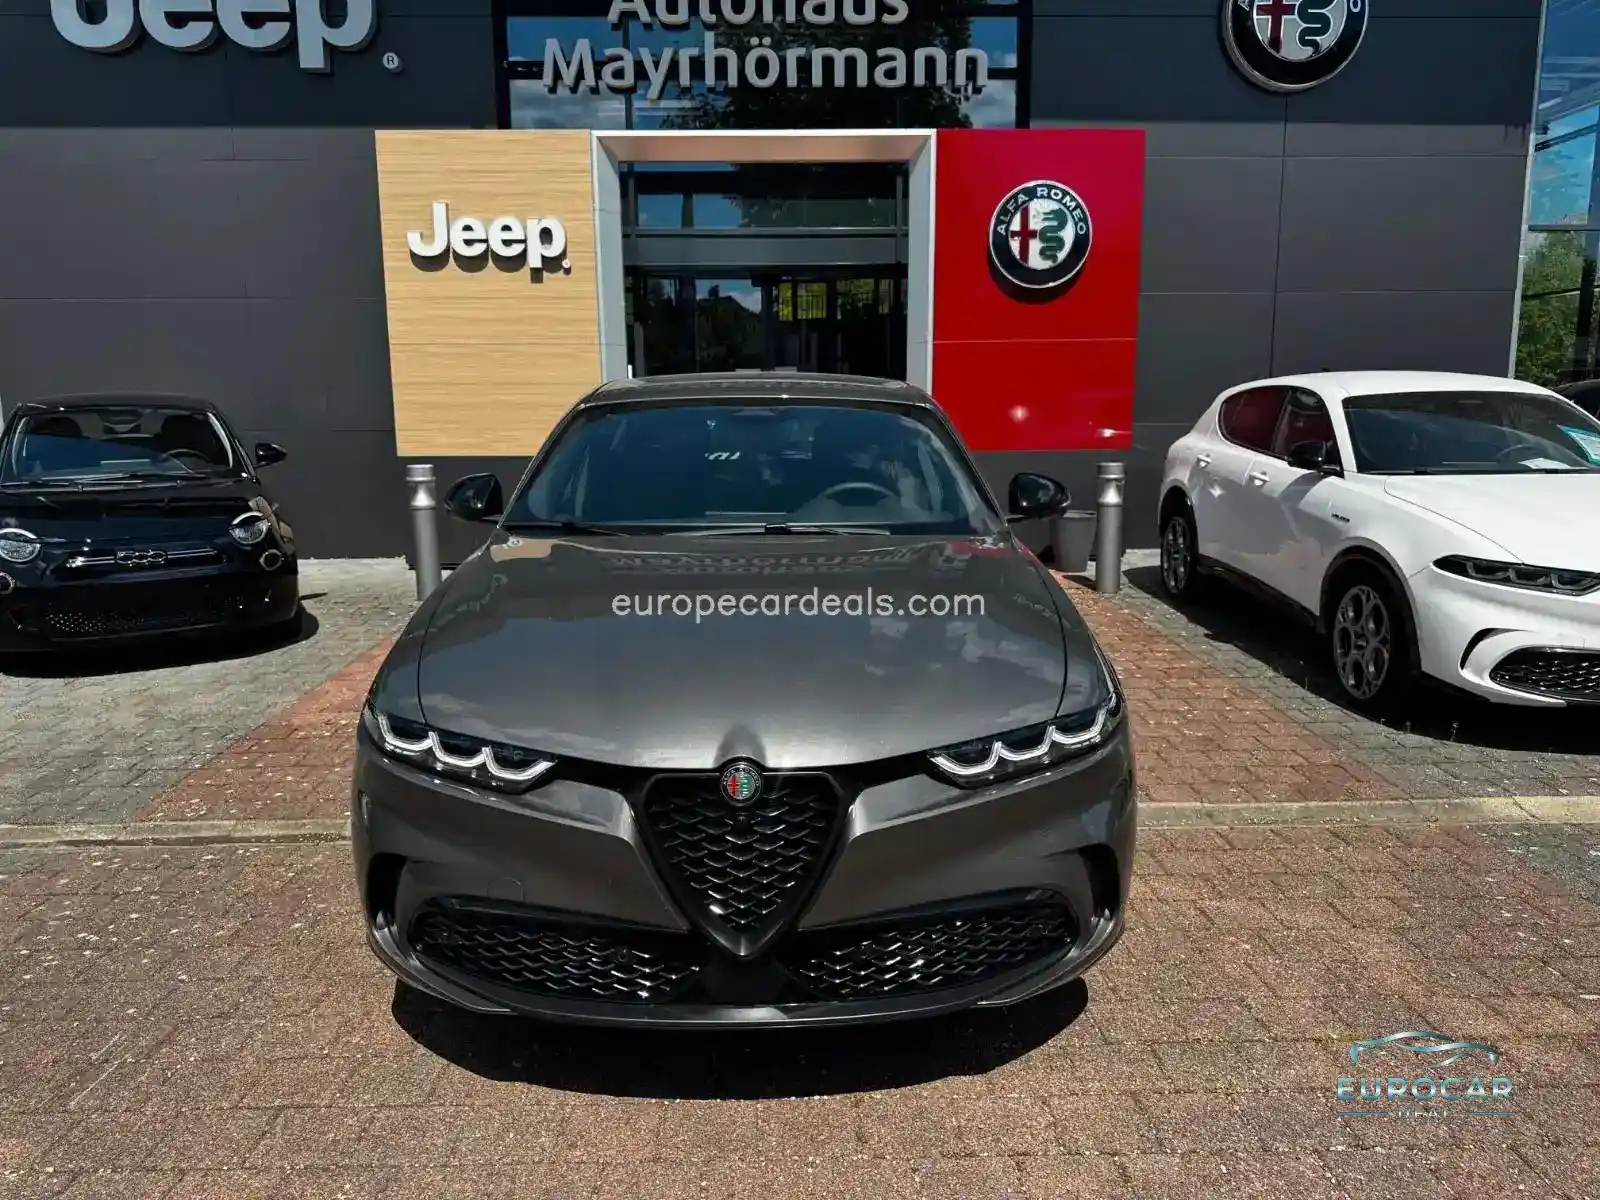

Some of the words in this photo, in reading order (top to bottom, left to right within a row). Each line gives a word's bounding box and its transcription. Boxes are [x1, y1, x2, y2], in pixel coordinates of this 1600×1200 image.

[541, 30, 990, 100] Mayrhörmann
[406, 201, 566, 269] Jeep
[997, 193, 1029, 236] ALFA
[1036, 186, 1087, 235] ROMEO
